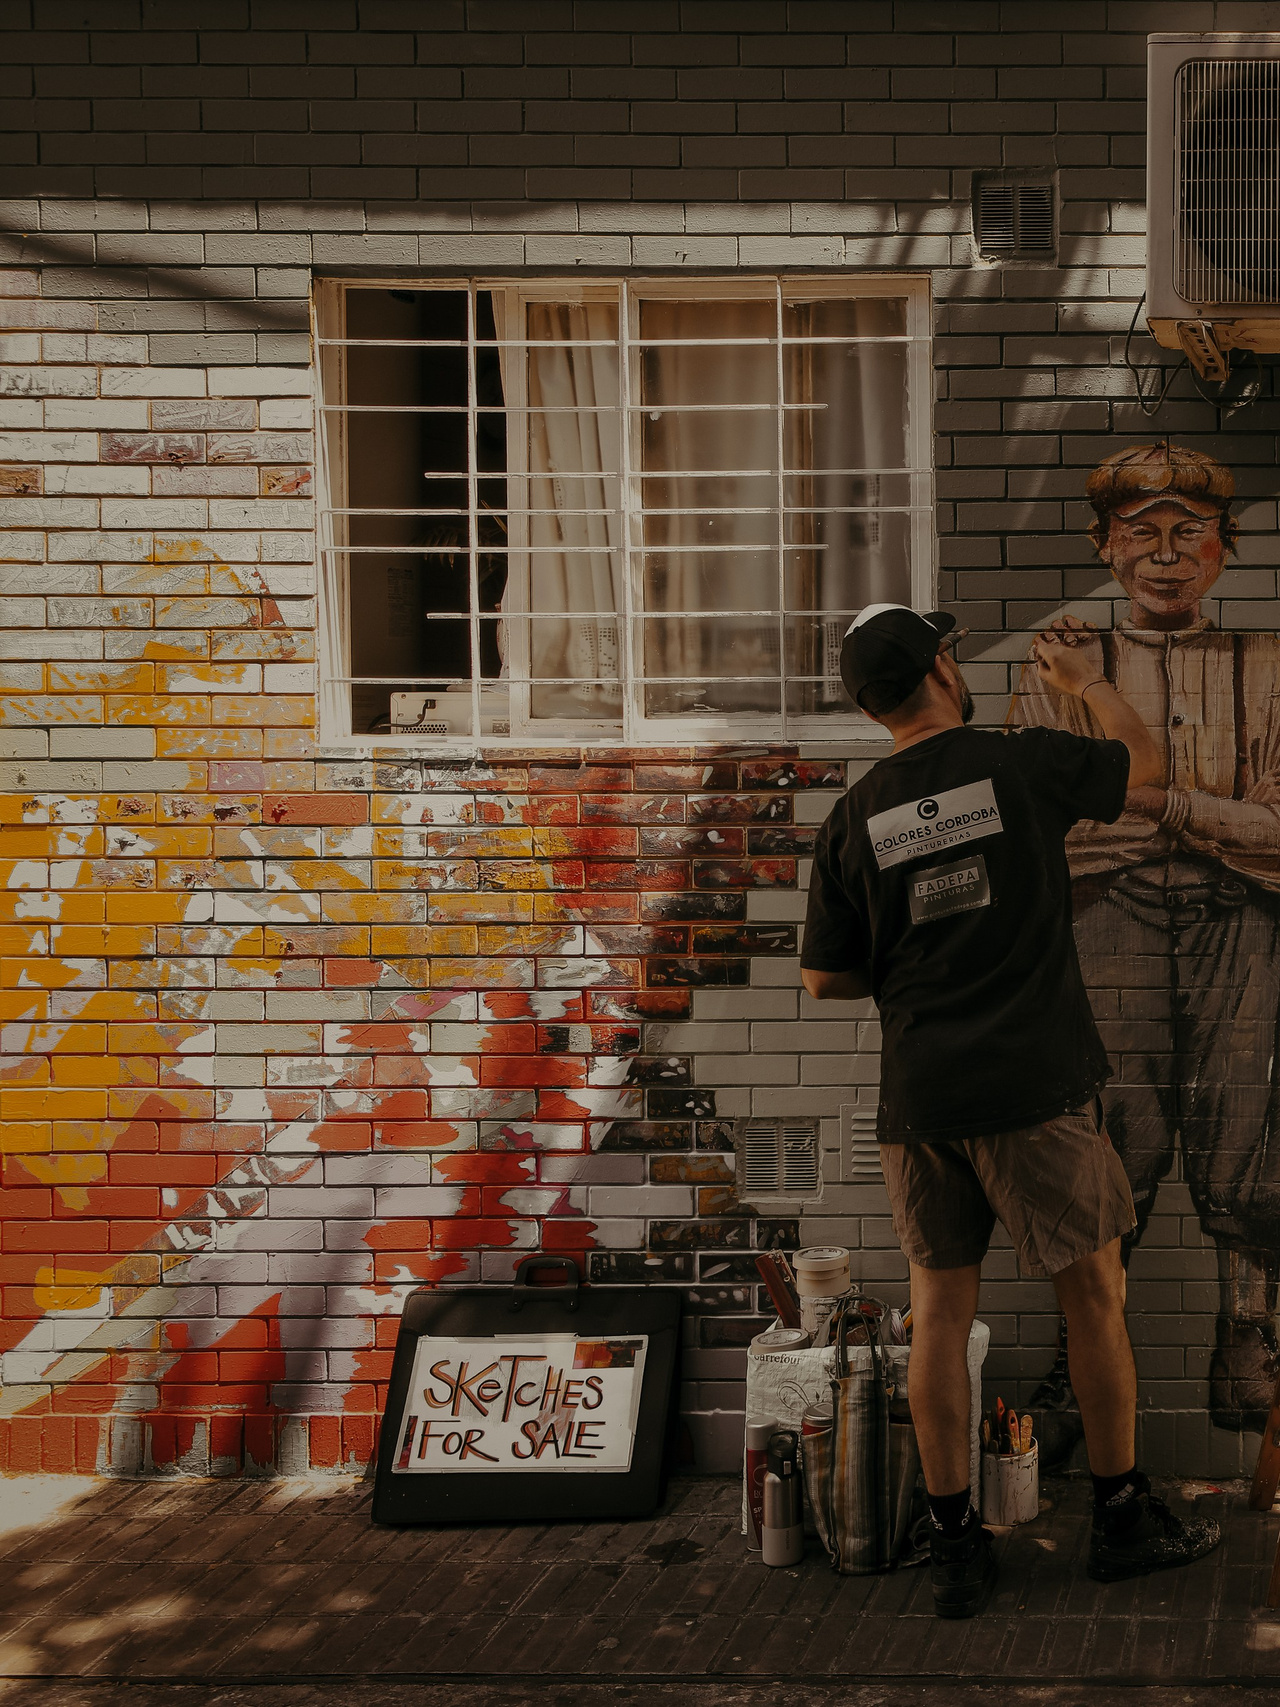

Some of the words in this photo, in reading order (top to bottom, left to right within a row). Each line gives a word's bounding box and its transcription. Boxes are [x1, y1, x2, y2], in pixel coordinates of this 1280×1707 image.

[874, 825, 932, 853] COLORES
[936, 806, 998, 833] CORDOBA
[906, 831, 972, 856] PINTURERIAS
[917, 870, 977, 895] FADEPA
[923, 884, 975, 904] PINTURAS
[417, 1420, 499, 1462] FOR
[511, 1420, 606, 1460] SALE
